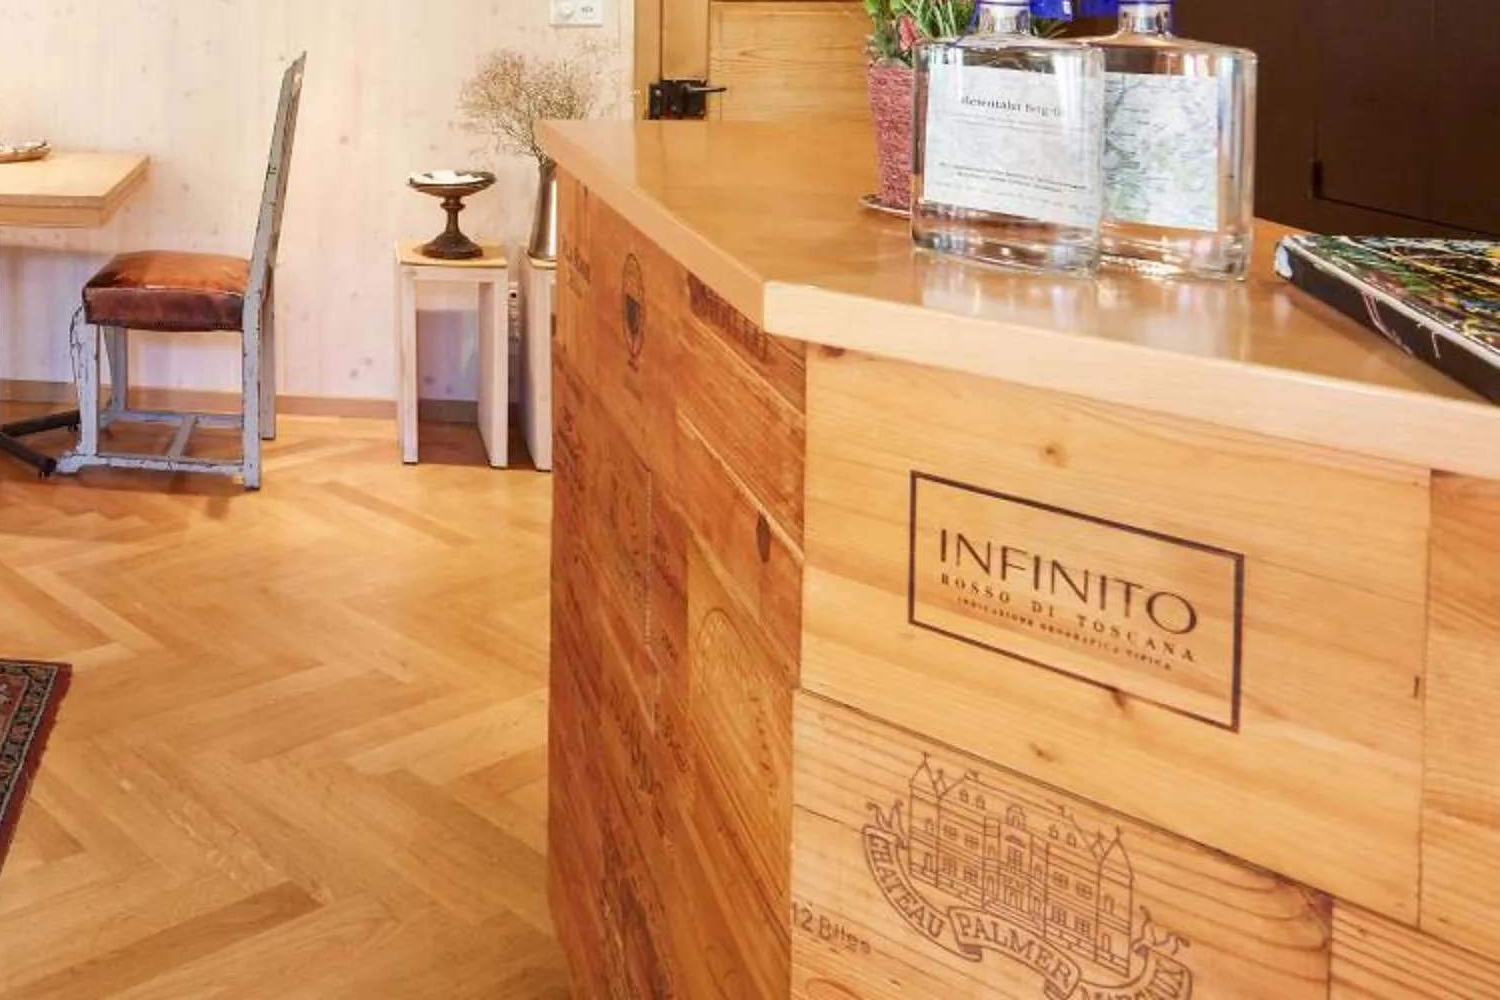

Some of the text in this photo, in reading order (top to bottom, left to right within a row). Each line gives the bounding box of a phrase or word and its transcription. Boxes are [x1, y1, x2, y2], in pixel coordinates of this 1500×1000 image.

[938, 528, 1198, 635] INFINITO
[940, 572, 1197, 664] ROSSO DI TOSCANA
[956, 912, 1073, 990] PALMER
